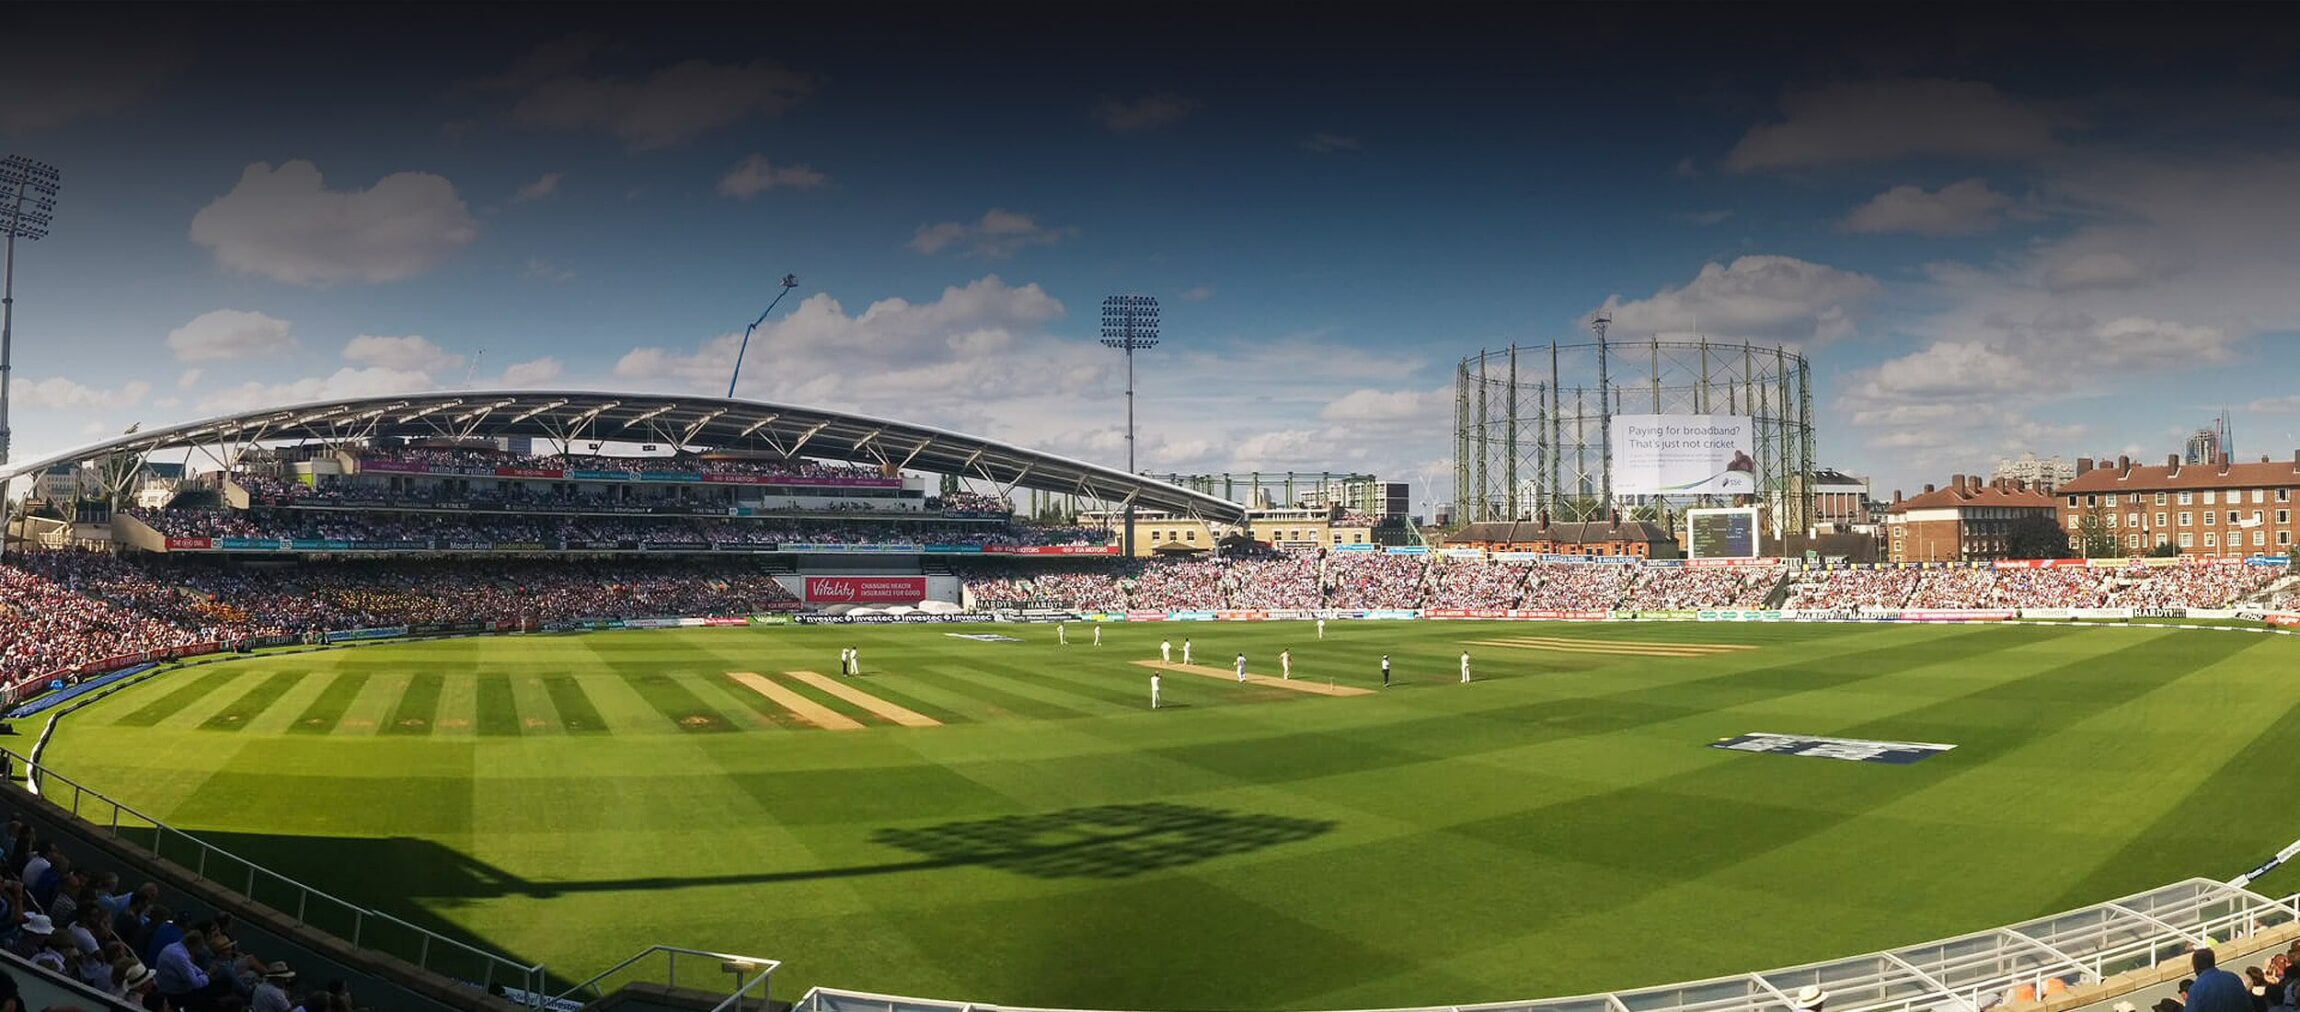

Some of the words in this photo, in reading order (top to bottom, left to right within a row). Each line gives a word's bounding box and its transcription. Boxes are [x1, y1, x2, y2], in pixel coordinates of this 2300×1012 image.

[1628, 426, 1664, 438] Paying
[1666, 426, 1680, 435] for
[1683, 426, 1741, 436] broadband?
[1629, 439, 1660, 449] That's
[1660, 440, 1680, 450] just
[1682, 440, 1700, 449] not
[1703, 440, 1735, 449] cricket
[449, 541, 473, 549] Mount
[812, 578, 856, 601] Vitality
